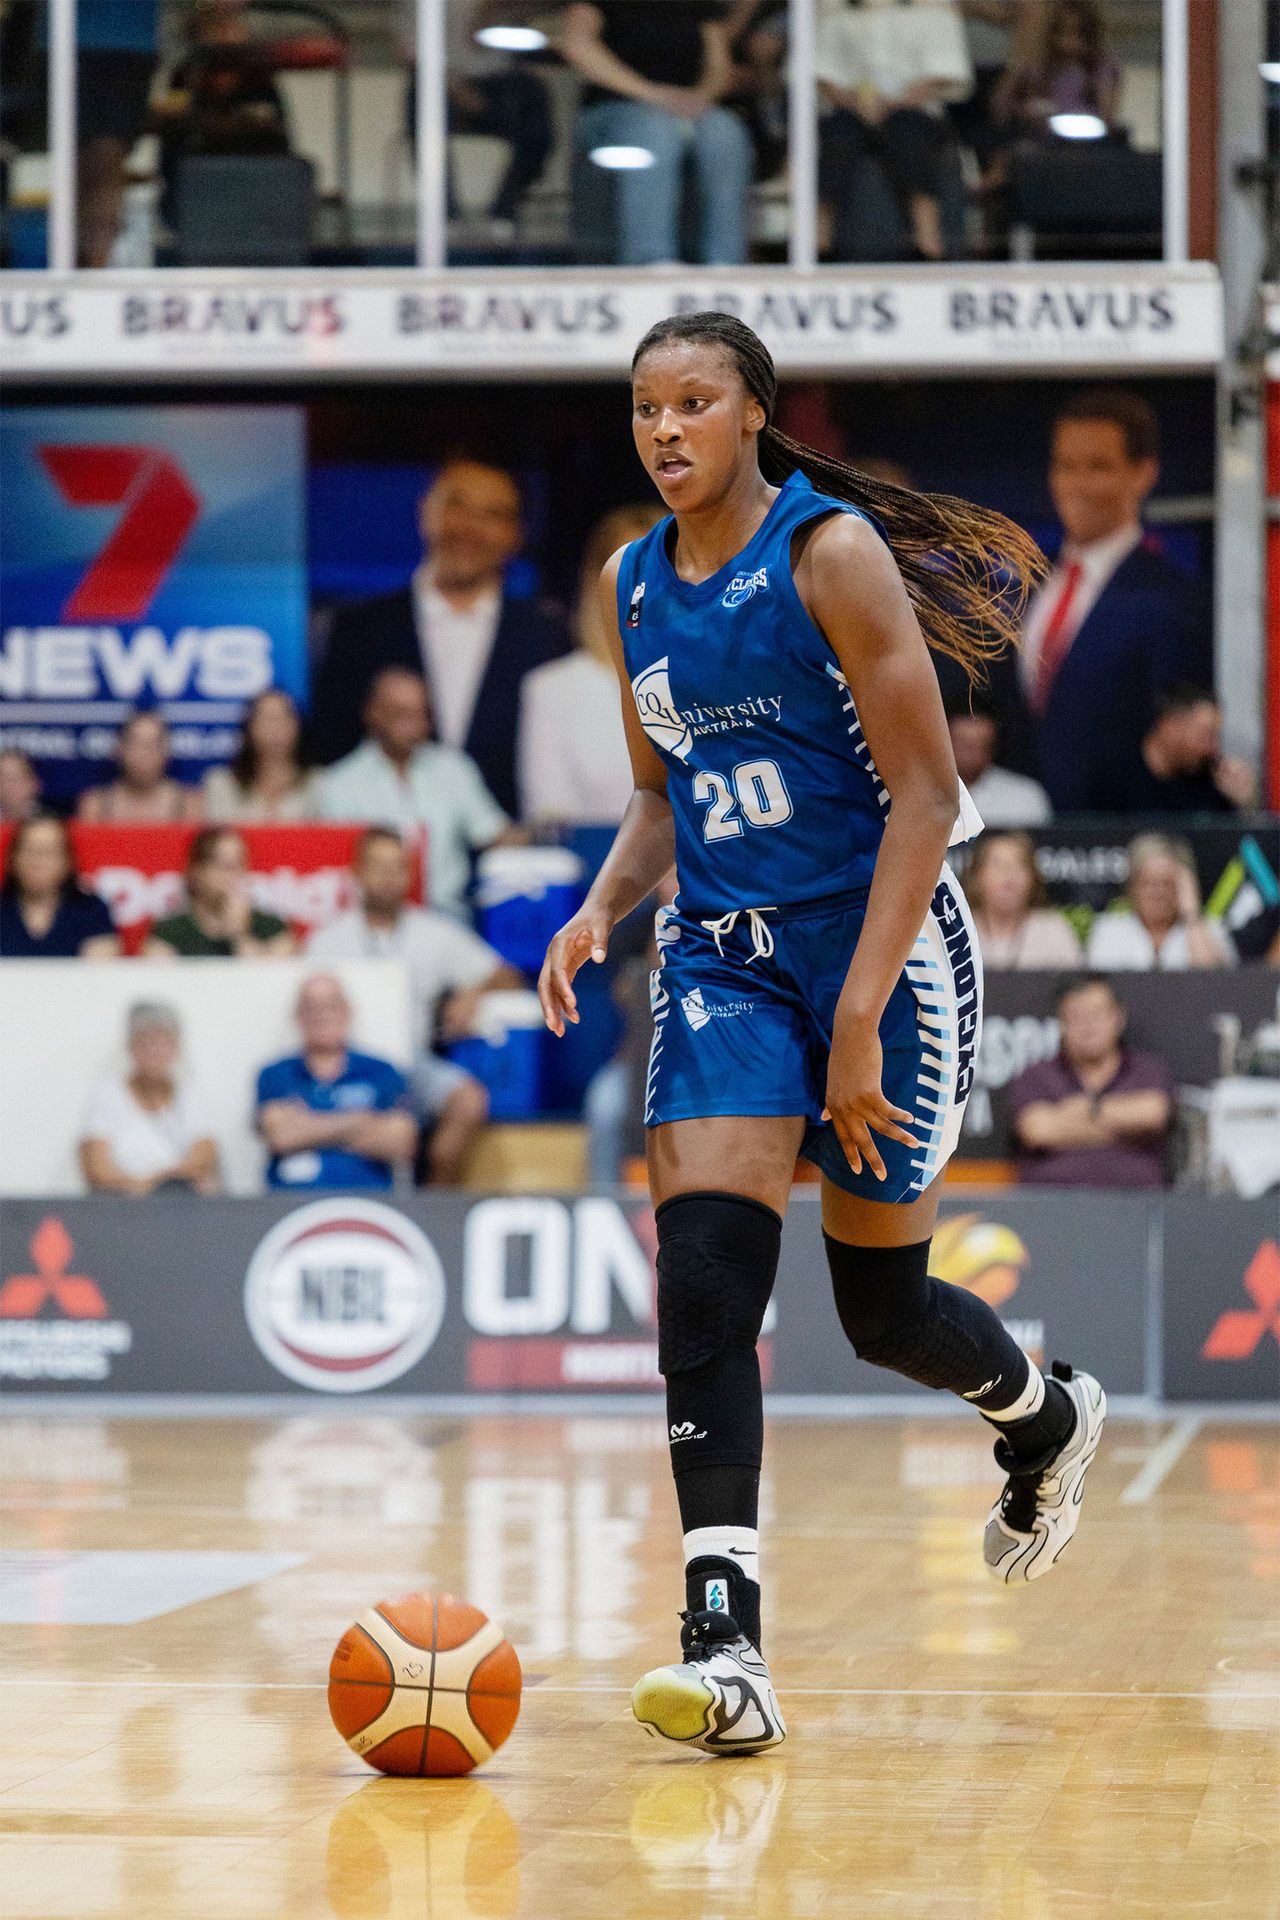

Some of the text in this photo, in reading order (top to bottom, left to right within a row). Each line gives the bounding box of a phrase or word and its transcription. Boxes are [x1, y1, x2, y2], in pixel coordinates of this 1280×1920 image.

[122, 296, 344, 336] BRAVUS
[398, 294, 622, 336] BRAVUS
[948, 291, 1175, 332] BRAVUS
[692, 758, 793, 844] 20
[931, 882, 979, 1106] CYCLONES
